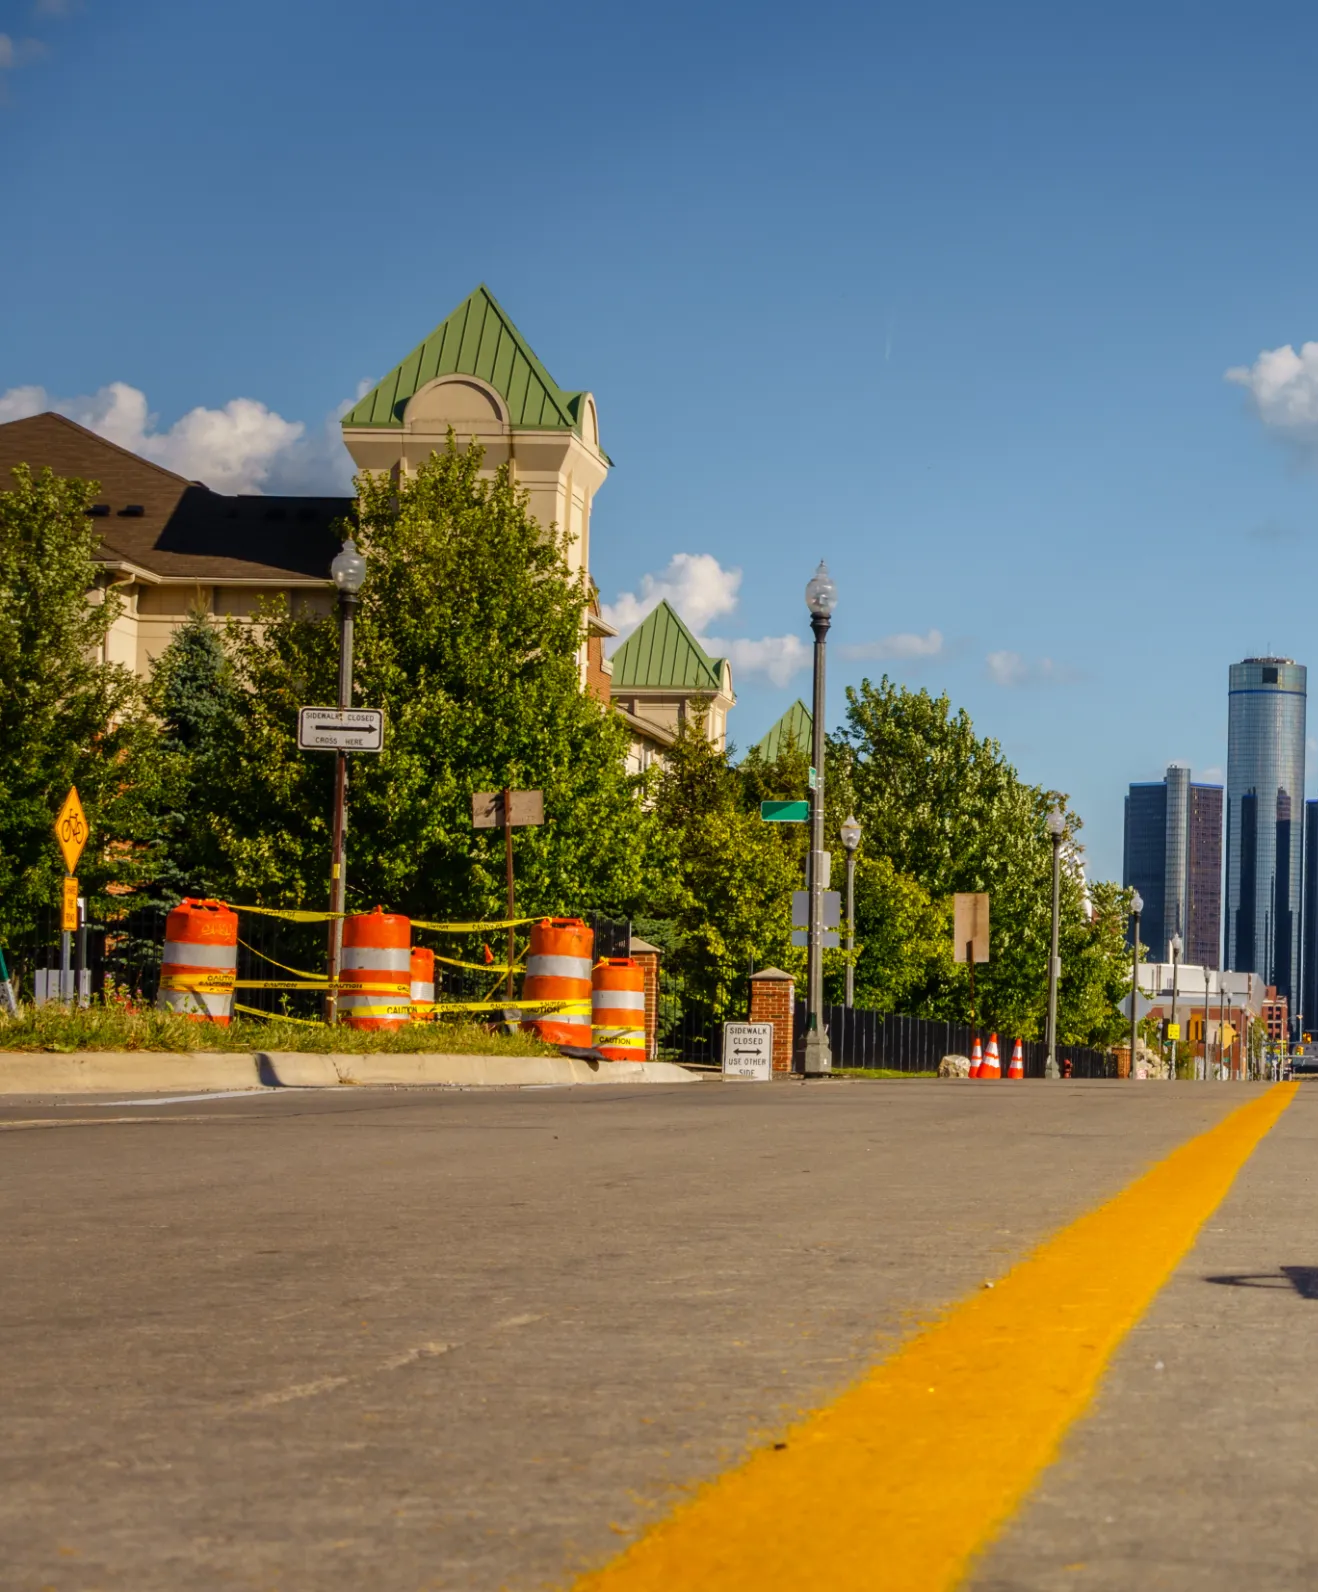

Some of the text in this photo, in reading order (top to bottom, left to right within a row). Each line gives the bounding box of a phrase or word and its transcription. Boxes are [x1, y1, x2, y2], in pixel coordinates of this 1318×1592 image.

[306, 712, 375, 722] SIDEWALK CLOSED
[345, 738, 364, 746] HERE
[328, 981, 363, 989] CAUTION
[386, 1006, 418, 1015] CAUTION
[526, 1006, 561, 1014] CAUTION
[729, 1027, 768, 1035] SIDEWALK
[599, 1036, 631, 1045] CAUTION
[733, 1037, 763, 1045] CLOSED
[728, 1058, 767, 1066] USE OTHER
